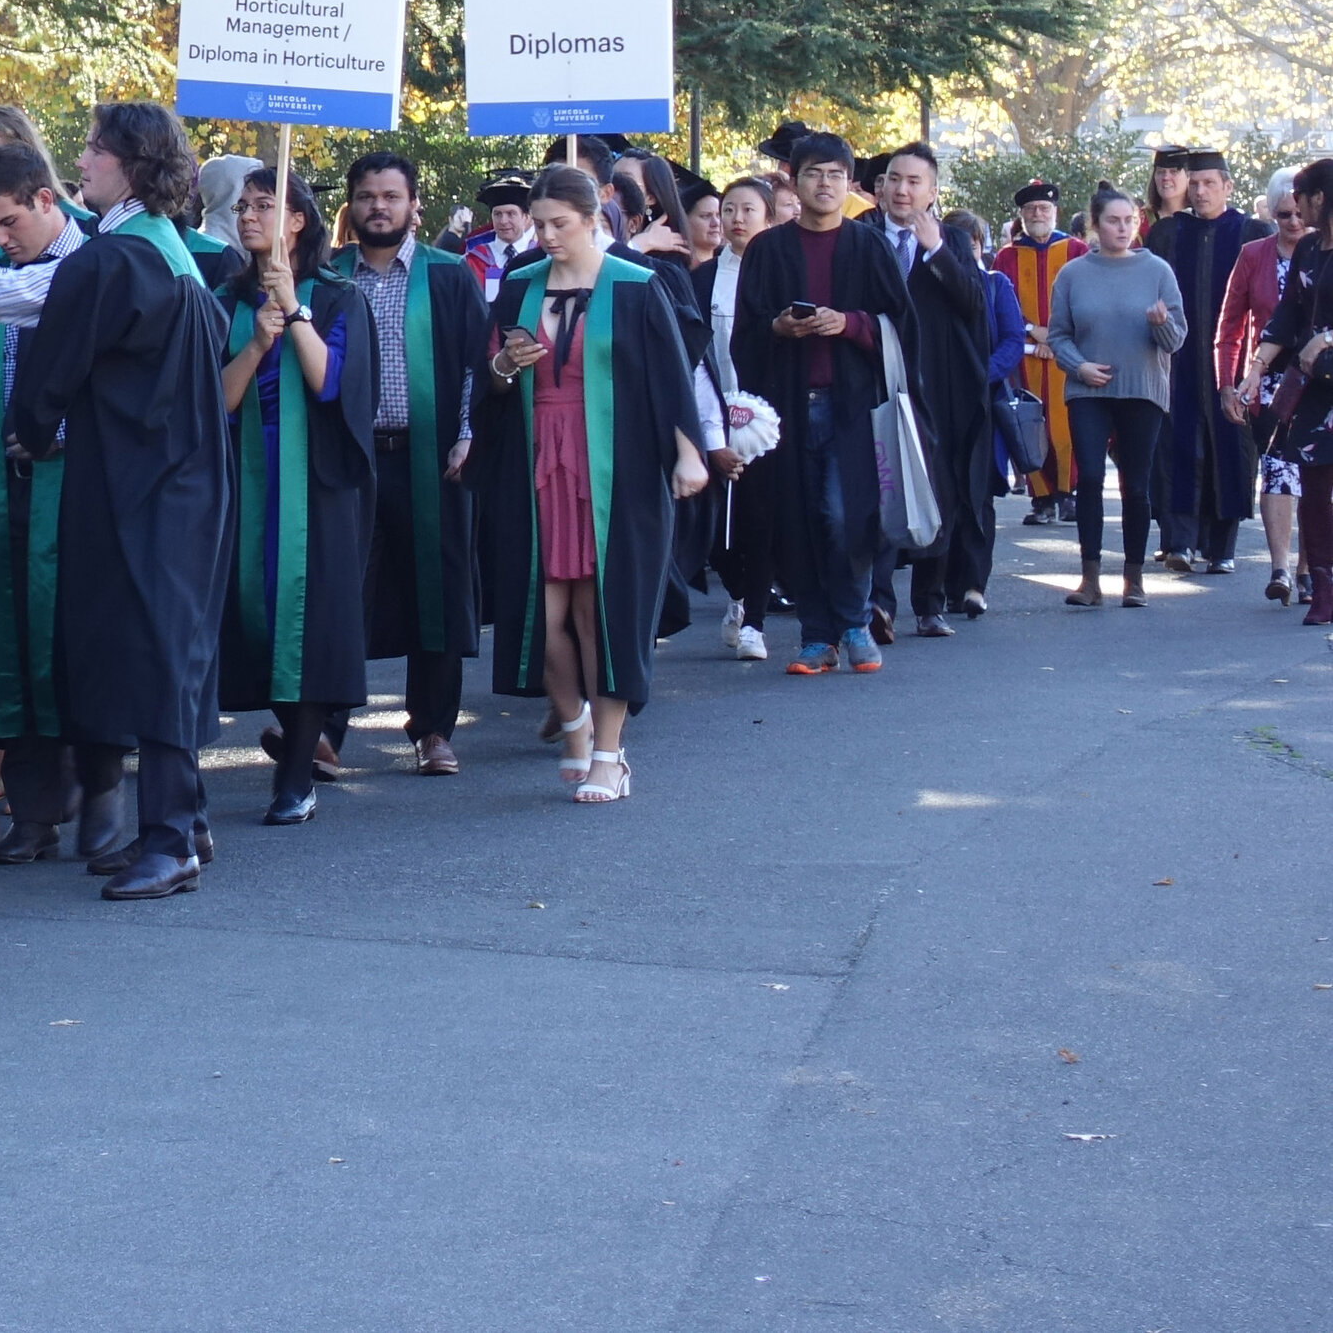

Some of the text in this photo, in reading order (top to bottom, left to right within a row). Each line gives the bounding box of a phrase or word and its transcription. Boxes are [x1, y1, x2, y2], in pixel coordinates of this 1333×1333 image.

[226, 17, 352, 42] Management /
[509, 32, 624, 59] Diplomas
[188, 44, 385, 72] Diploma in Horticulture
[268, 94, 307, 103] LINCOLN
[268, 101, 323, 111] UNIVERSITY
[553, 108, 590, 116] LINCOLN
[553, 114, 605, 122] UNIVERSITY
